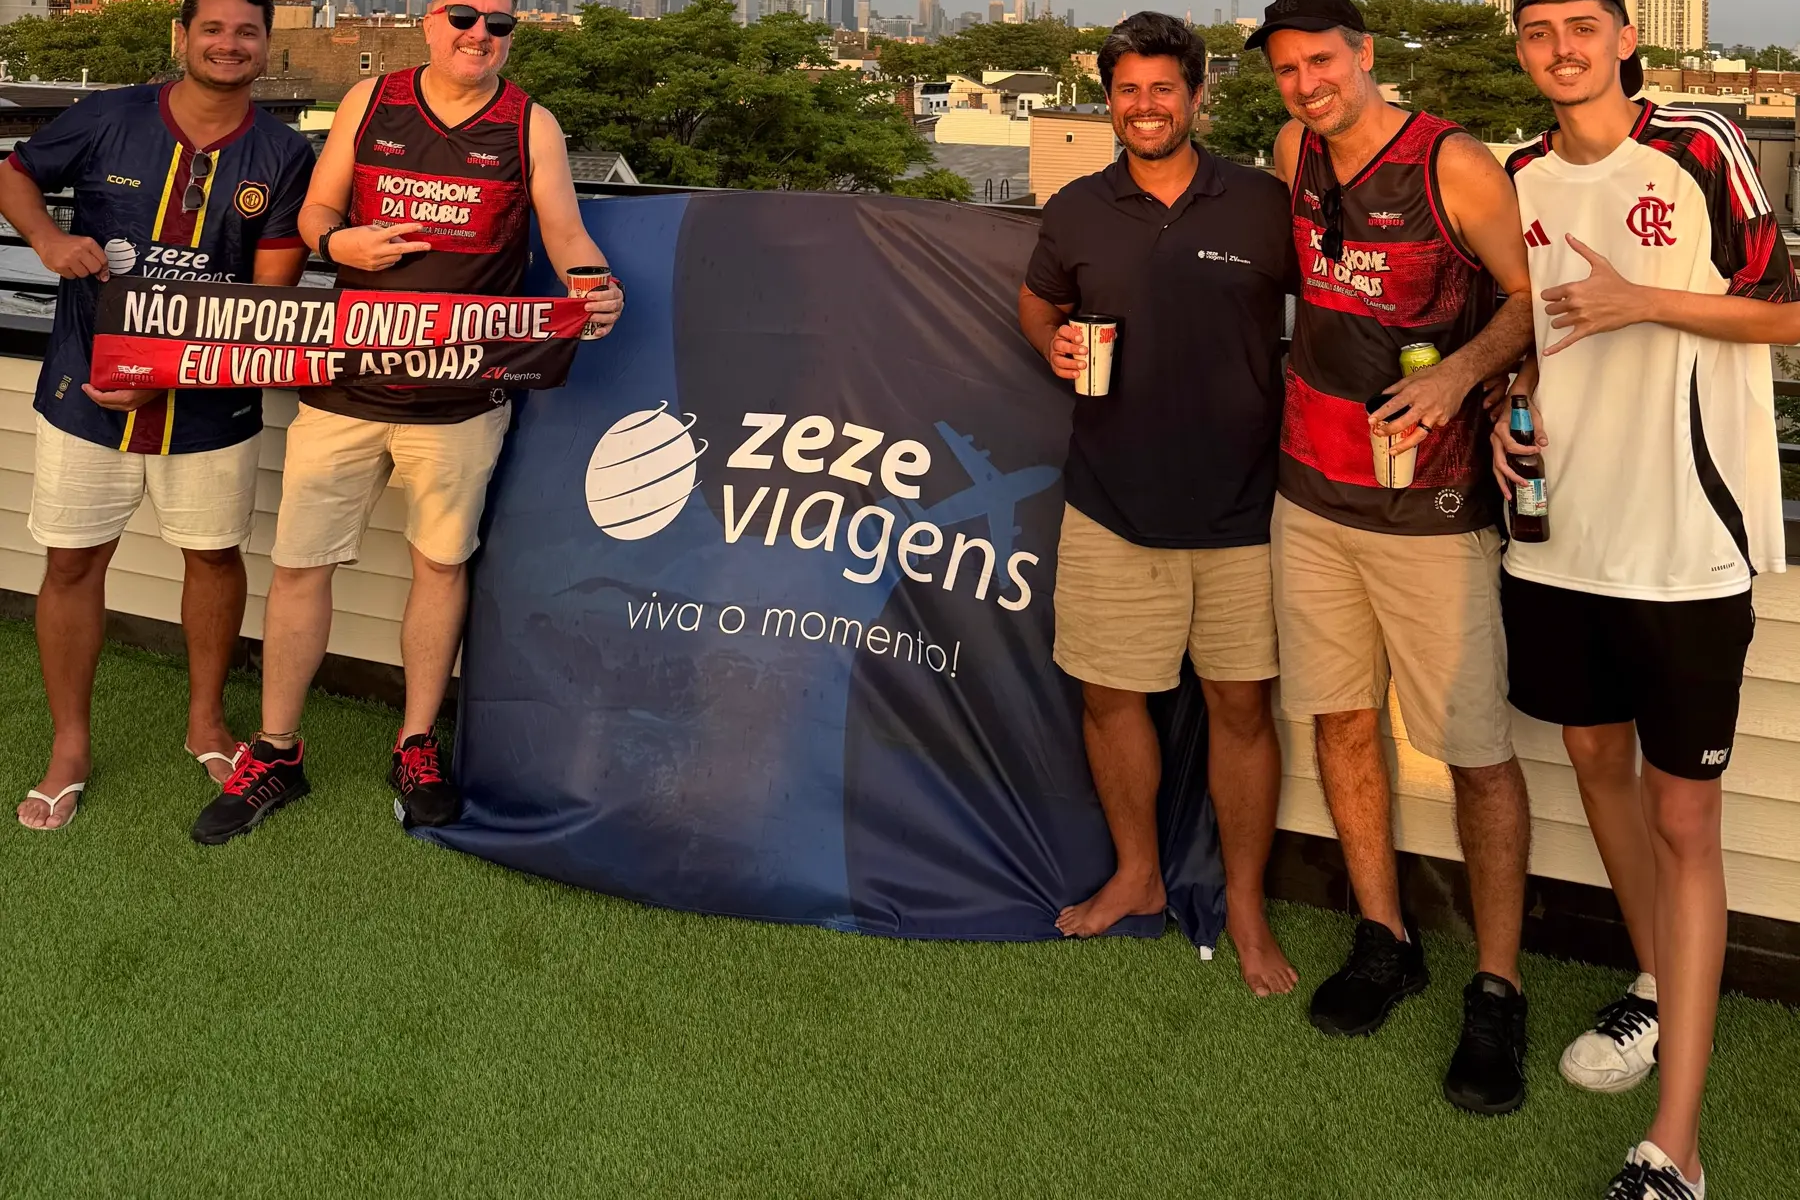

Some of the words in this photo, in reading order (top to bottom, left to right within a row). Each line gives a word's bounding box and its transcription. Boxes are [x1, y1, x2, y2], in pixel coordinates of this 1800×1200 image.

[376, 174, 482, 204] MOTORHOME
[381, 197, 405, 218] DA
[410, 202, 471, 225] URUBUS
[145, 246, 210, 270] zeze
[123, 284, 188, 337] NÃO
[195, 296, 336, 344] IMPORTA
[344, 301, 440, 347] ONDE
[444, 302, 558, 344] JOGUE,
[178, 344, 224, 385] EU
[230, 346, 296, 386] VOU
[305, 350, 346, 384] TE
[358, 344, 484, 380] APOIAR
[726, 412, 932, 499] zeze
[722, 484, 1040, 612] viagens
[627, 591, 703, 632] viva
[719, 605, 746, 635] o
[761, 607, 961, 679] momento!
